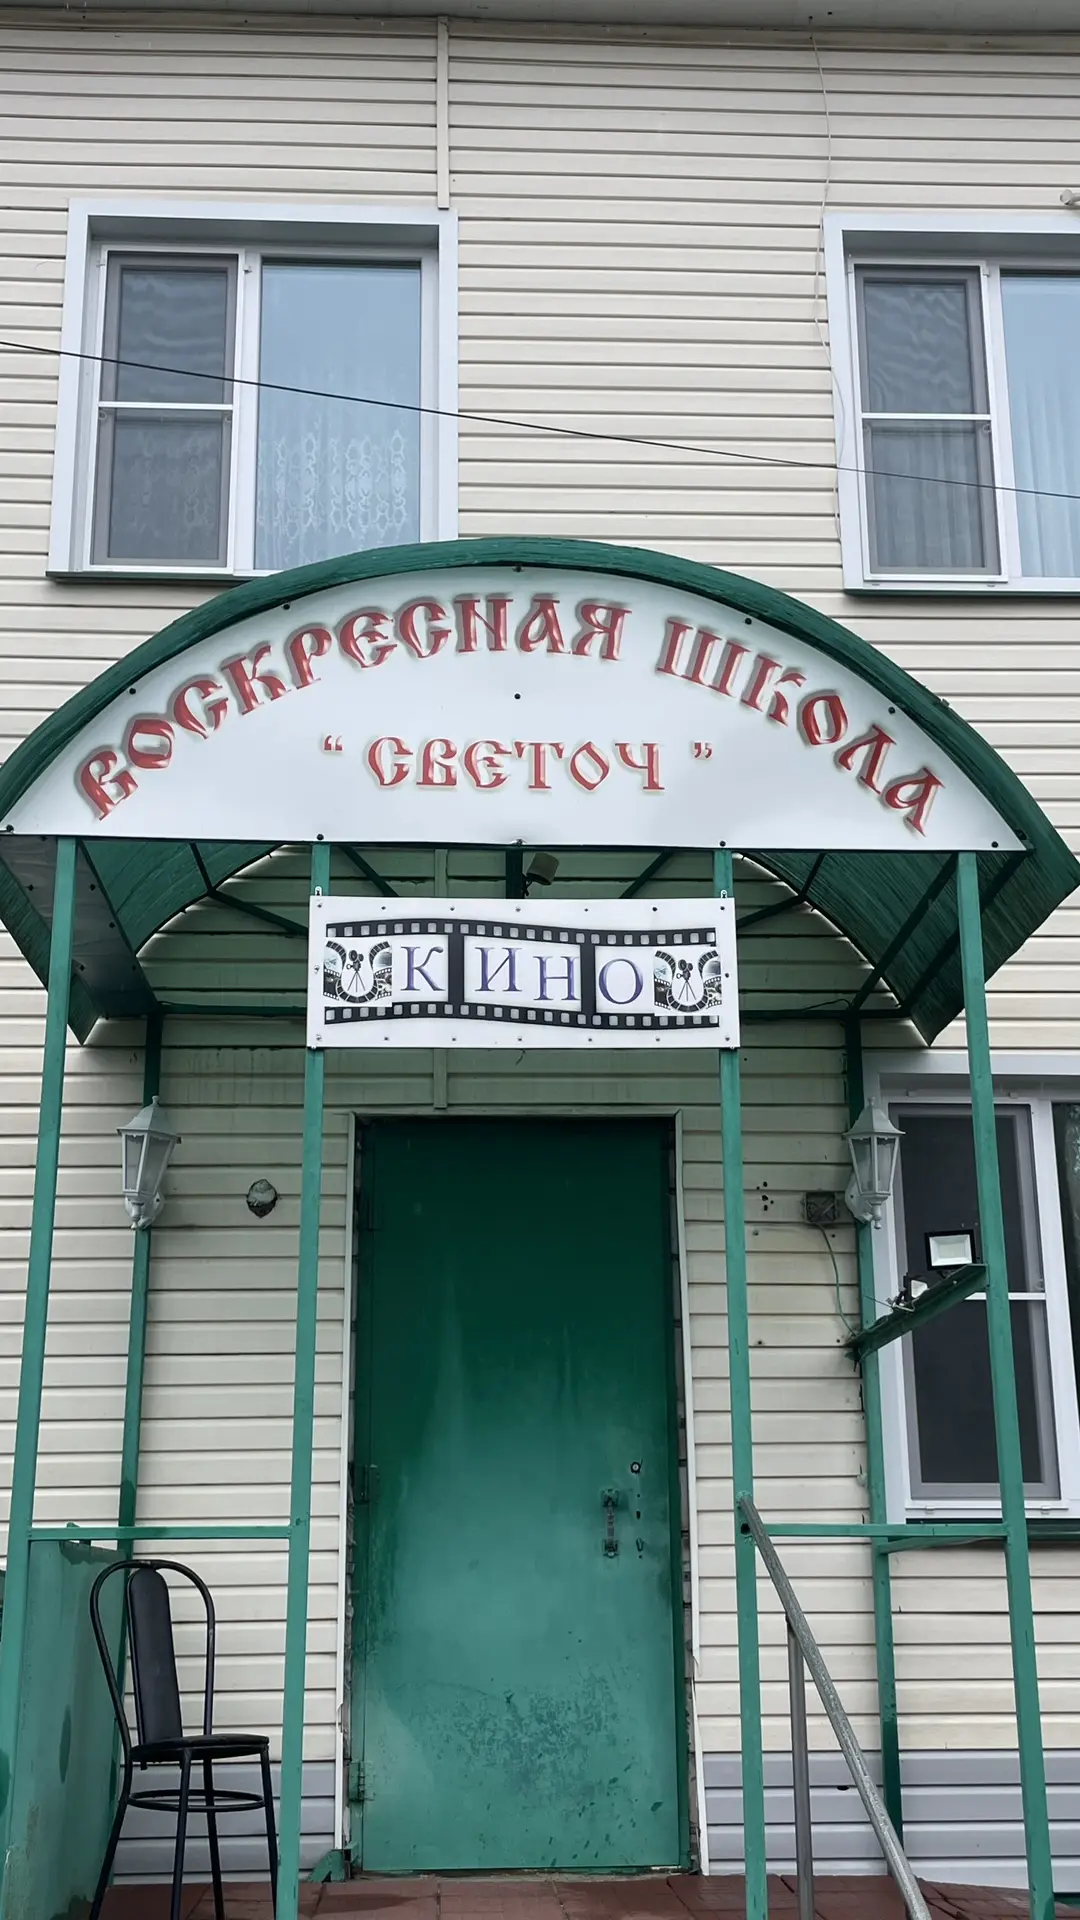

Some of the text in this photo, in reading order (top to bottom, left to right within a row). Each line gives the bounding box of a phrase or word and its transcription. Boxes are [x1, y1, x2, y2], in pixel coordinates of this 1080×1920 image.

[78, 596, 944, 837] ВОСКРЕСНАЯ ШКОЛА
[399, 944, 644, 1006] КИНО
